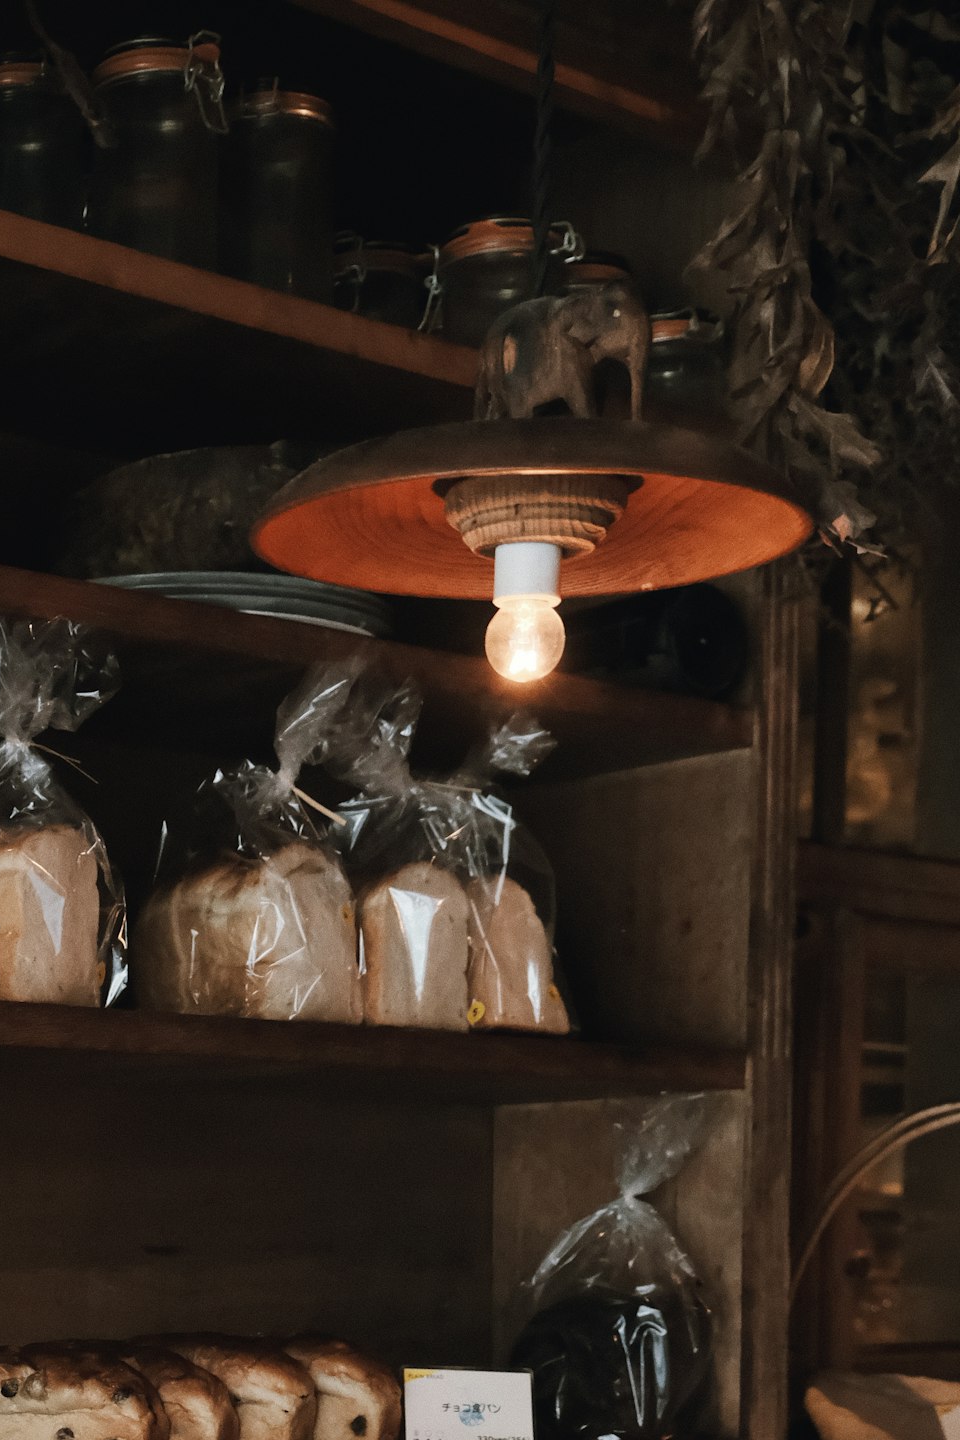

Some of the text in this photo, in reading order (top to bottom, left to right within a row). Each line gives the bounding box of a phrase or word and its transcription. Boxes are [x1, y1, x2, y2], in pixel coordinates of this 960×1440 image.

[442, 1403, 501, 1413] チョコ食パン
